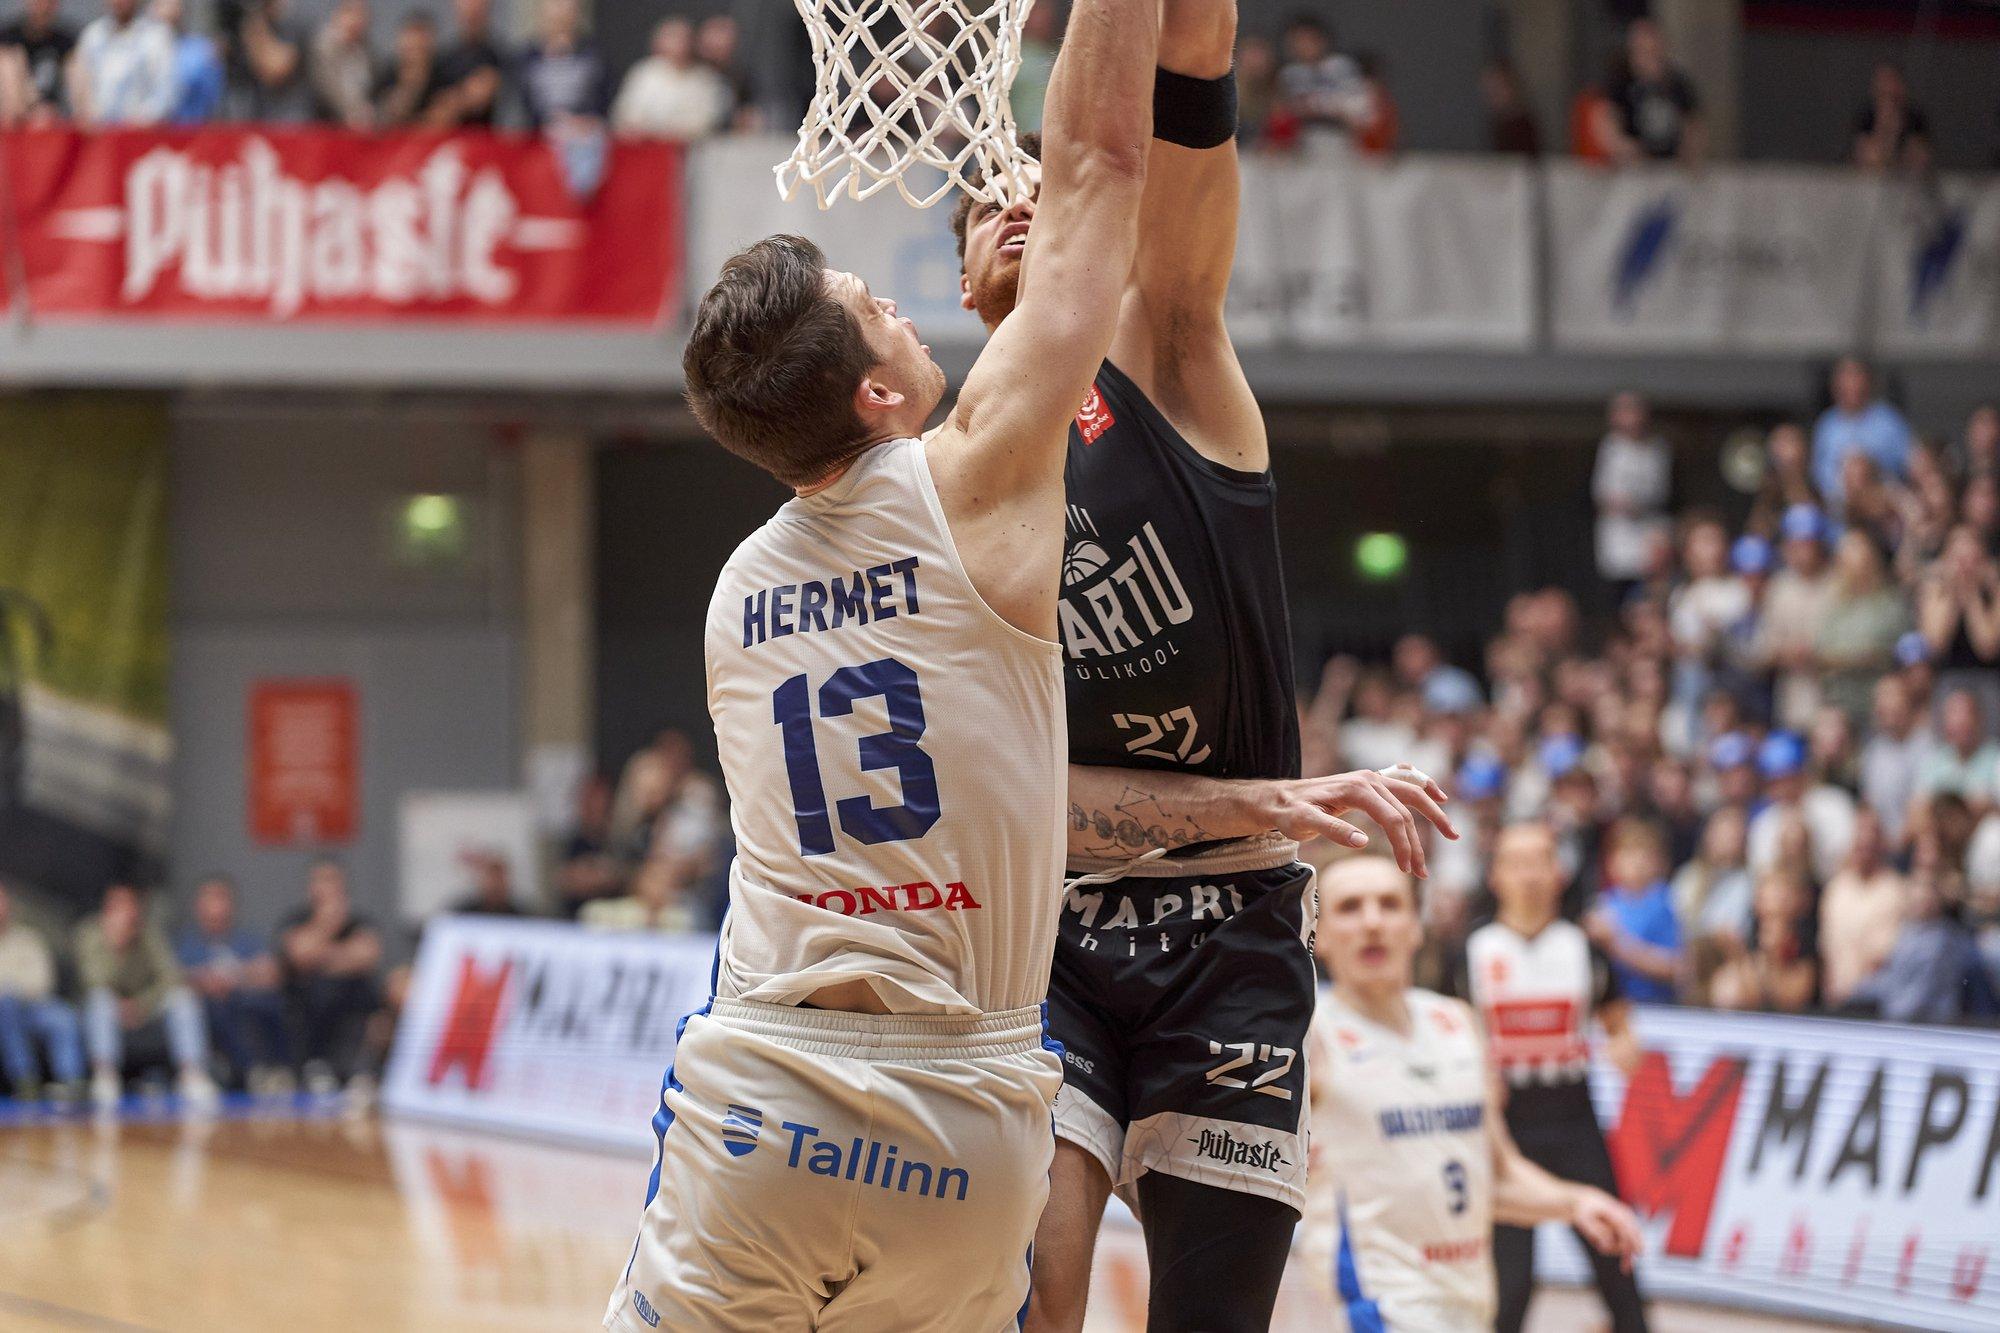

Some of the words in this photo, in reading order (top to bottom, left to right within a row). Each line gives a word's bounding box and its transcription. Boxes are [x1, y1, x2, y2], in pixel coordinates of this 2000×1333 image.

[743, 556, 919, 649] HERMET
[1058, 520, 1194, 661] ARTU
[1076, 640, 1180, 680] ÜLIKOOL
[773, 657, 942, 857] 13
[1112, 704, 1212, 765] 22
[1079, 932, 1206, 957] hitu
[1065, 1051, 1095, 1075] ess
[1206, 1040, 1297, 1100] 22
[782, 1121, 970, 1201] Tallinn
[1197, 1129, 1281, 1173] Pühaste
